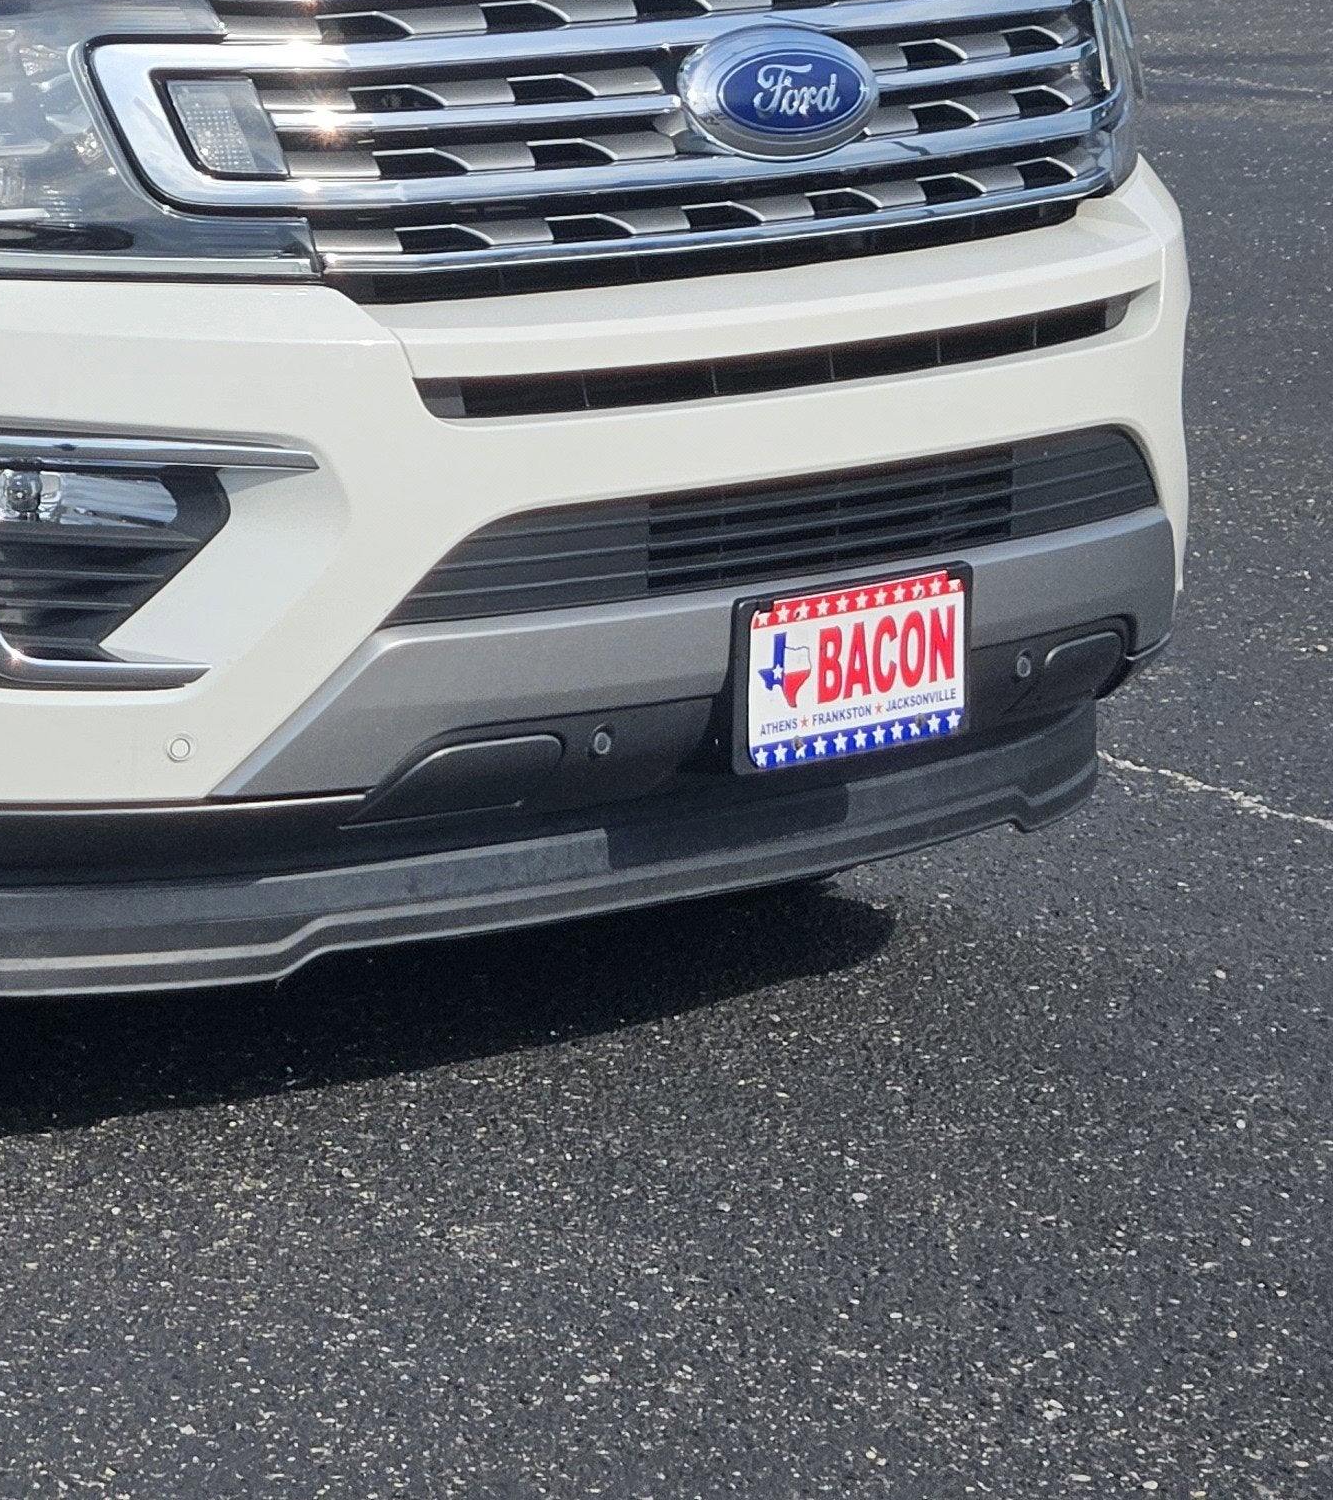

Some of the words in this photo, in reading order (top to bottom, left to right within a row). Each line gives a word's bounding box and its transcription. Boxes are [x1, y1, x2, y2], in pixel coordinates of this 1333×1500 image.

[753, 63, 840, 116] Ford
[817, 604, 956, 704] BACON
[760, 717, 798, 737] ATHENS
[812, 704, 872, 727] FRANKSTON
[885, 687, 957, 713] JACKSONVILLE
